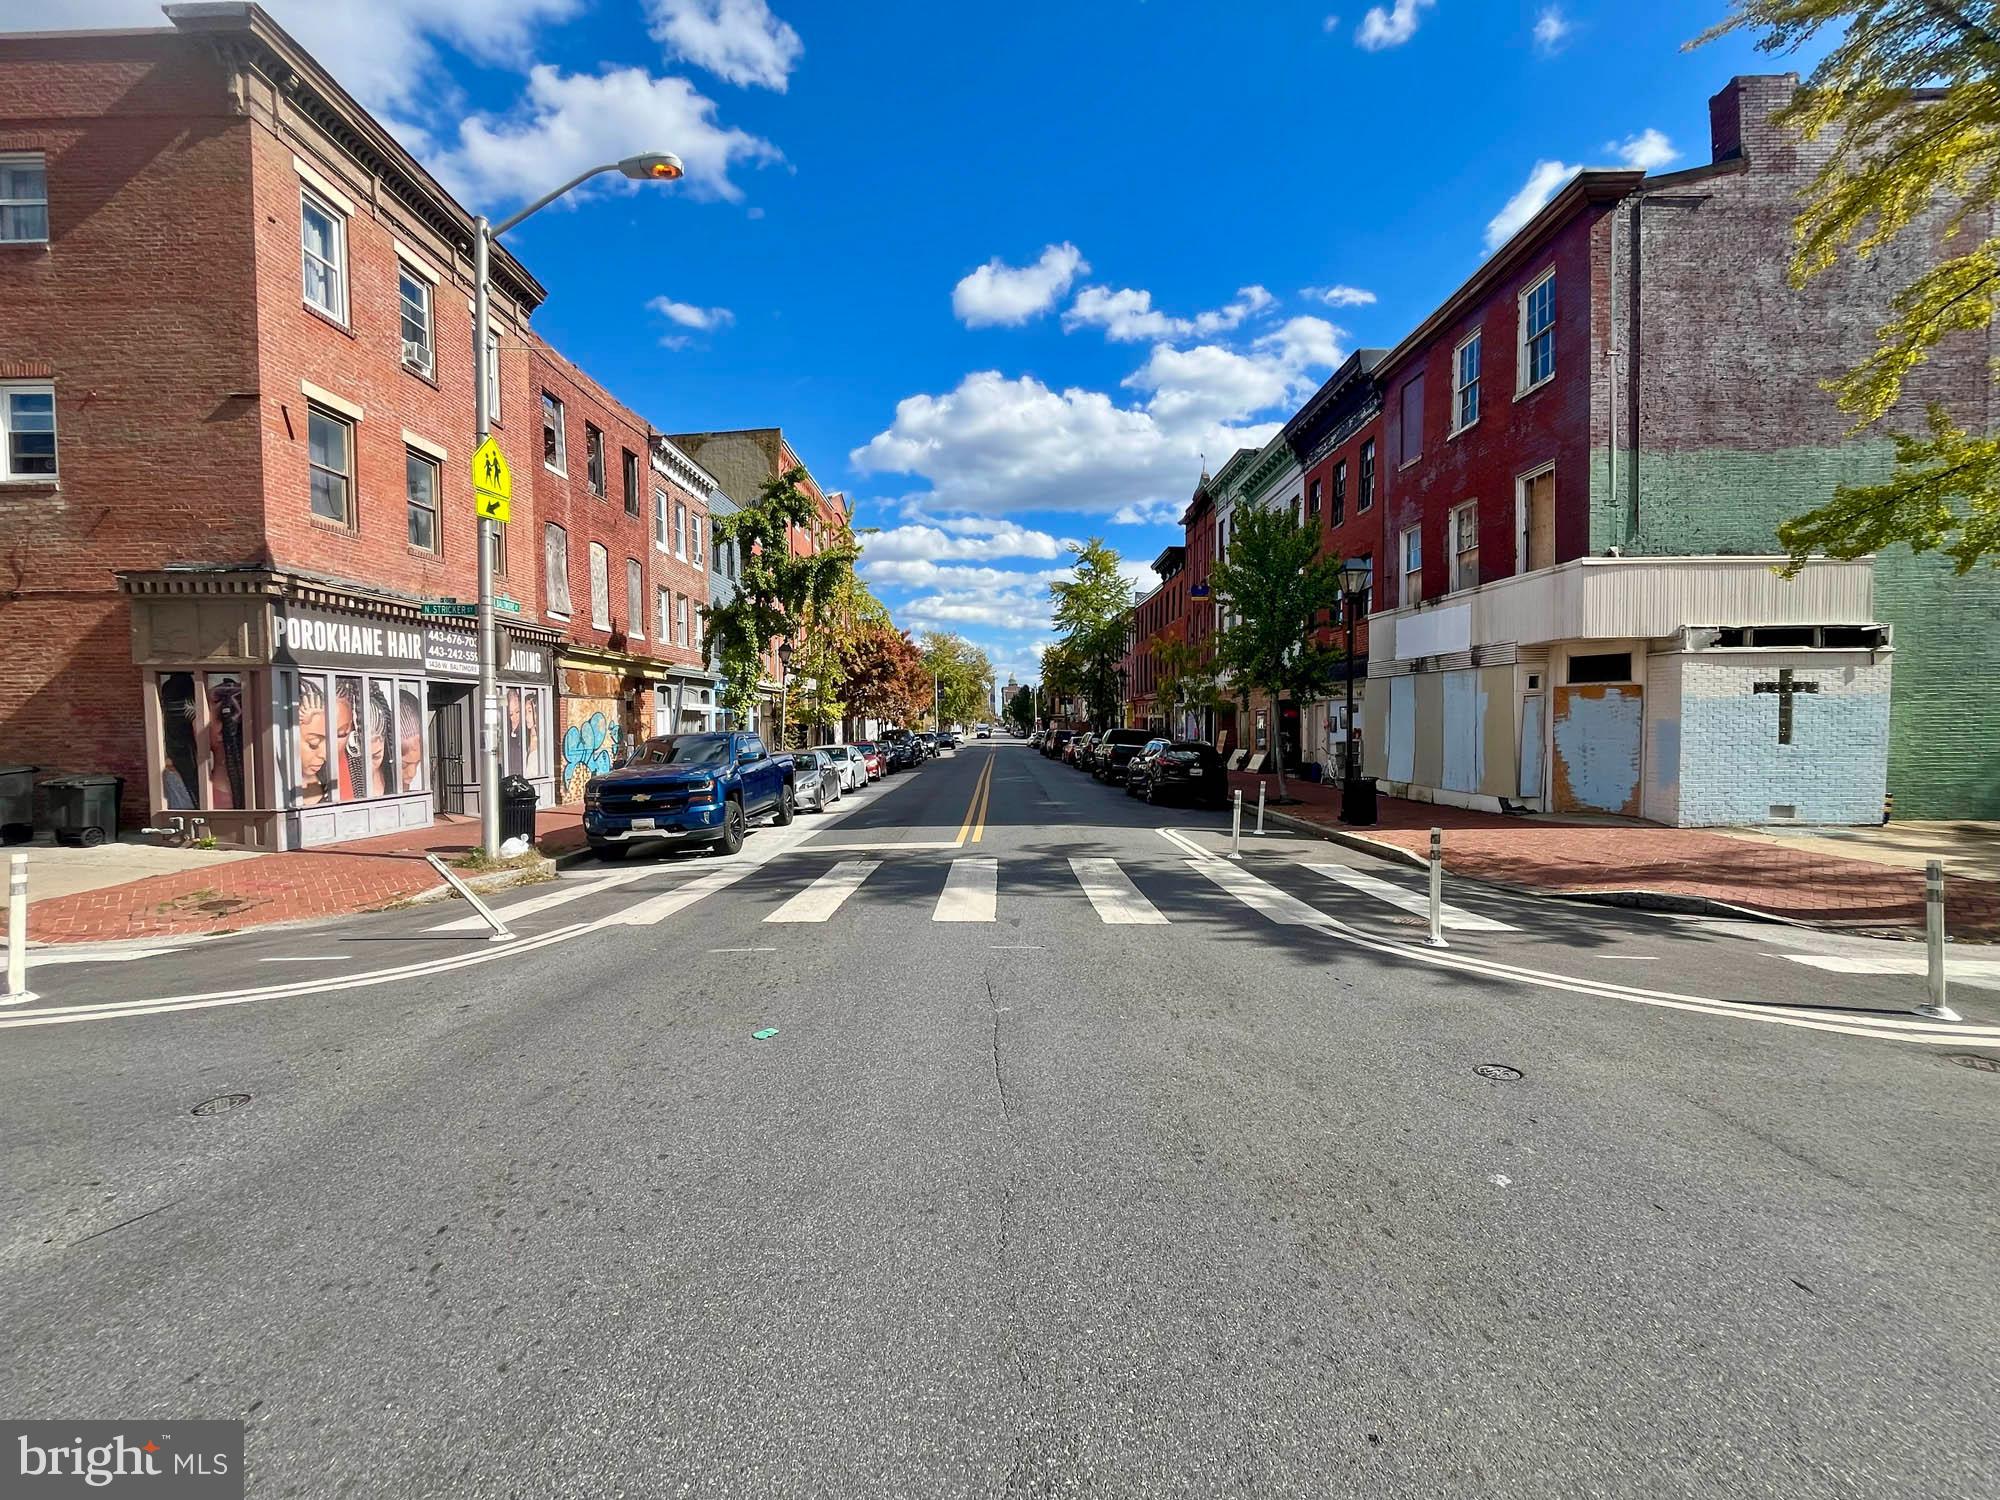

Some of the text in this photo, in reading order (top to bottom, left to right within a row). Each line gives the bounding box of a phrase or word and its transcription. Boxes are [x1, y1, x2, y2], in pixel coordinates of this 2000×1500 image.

[433, 605, 467, 614] STRICKER
[274, 616, 422, 659] POROKHANE HAIR
